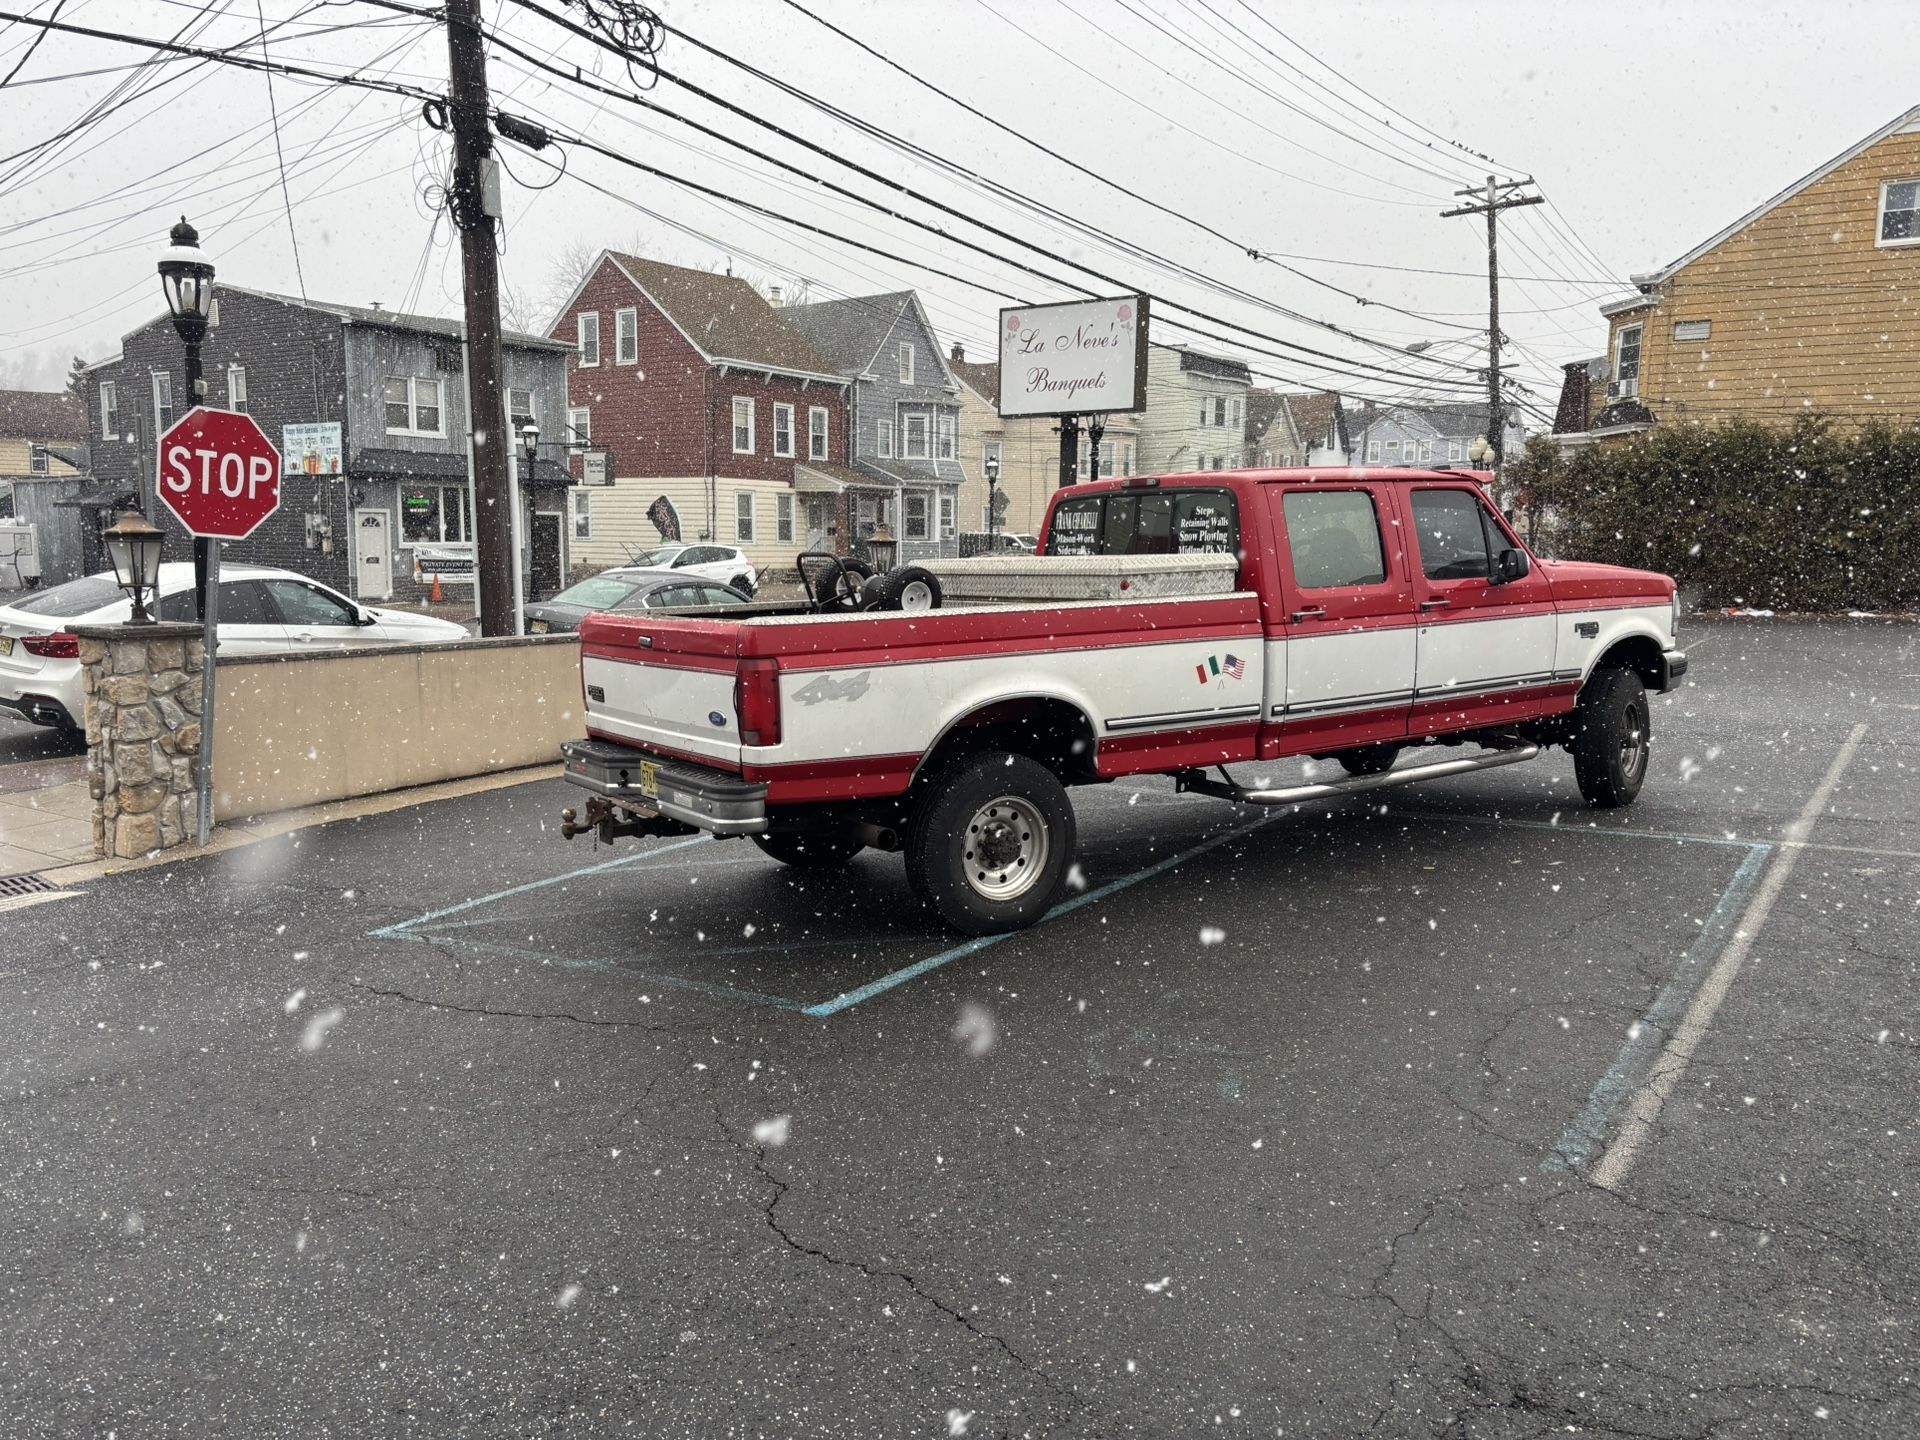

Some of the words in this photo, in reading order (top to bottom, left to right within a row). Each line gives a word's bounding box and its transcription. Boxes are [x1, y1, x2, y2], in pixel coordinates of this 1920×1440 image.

[1017, 328, 1045, 354] La
[1055, 322, 1118, 351] Neve's
[1026, 367, 1107, 399] Banquets
[166, 446, 273, 500] STOP
[1195, 505, 1215, 517] Steps
[1180, 518, 1210, 529] Retaining
[1211, 516, 1229, 526] Walls
[1179, 531, 1198, 542] Snow
[1199, 530, 1228, 544] Plowing
[1178, 545, 1205, 554] Midland
